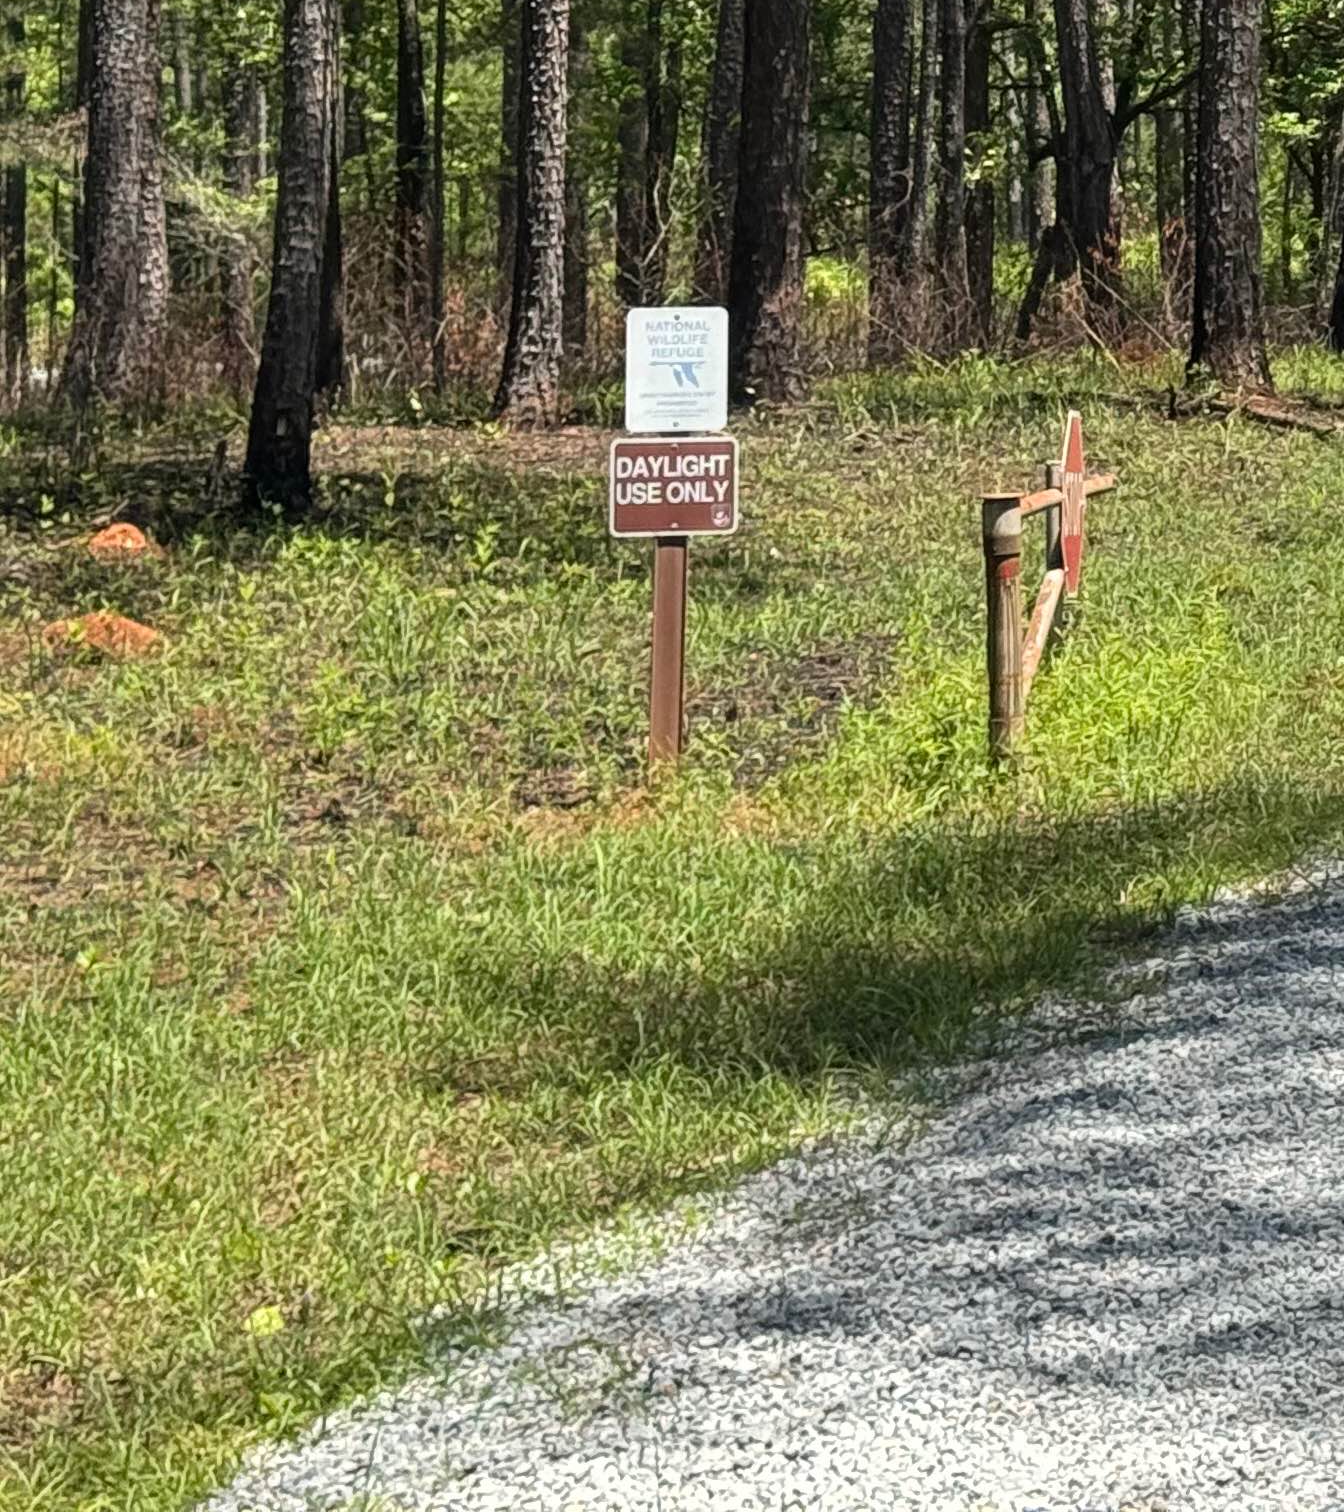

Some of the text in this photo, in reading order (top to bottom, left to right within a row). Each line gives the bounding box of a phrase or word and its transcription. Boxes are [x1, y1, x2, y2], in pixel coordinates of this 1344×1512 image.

[645, 320, 711, 332] NATIONAL
[647, 333, 708, 345] WILDLIFE
[651, 347, 704, 358] REFUGE
[616, 455, 730, 478] DAYLIGHT
[616, 480, 730, 504] USE ONLY
